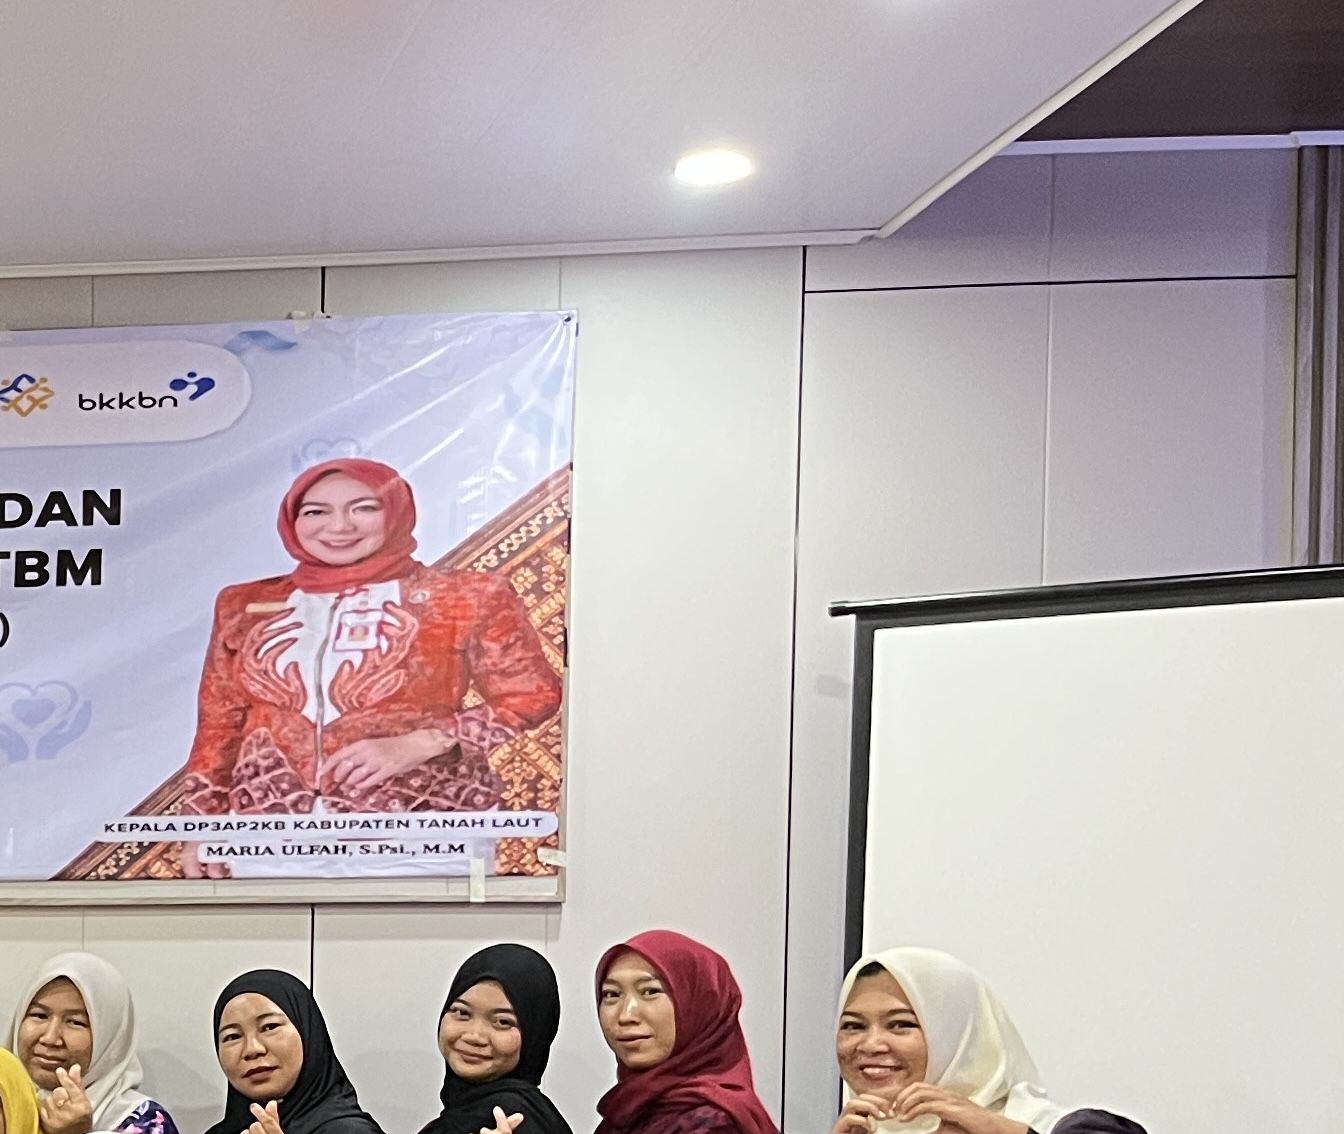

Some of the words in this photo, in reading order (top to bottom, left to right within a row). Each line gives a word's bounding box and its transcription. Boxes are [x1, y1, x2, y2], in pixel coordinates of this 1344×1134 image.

[78, 390, 178, 412] bkkbn
[104, 822, 177, 833] KEPALA
[293, 819, 410, 830] KABUPATEN
[417, 818, 485, 829] TANAH
[491, 817, 542, 828] LAUT
[206, 845, 275, 856] MARIA
